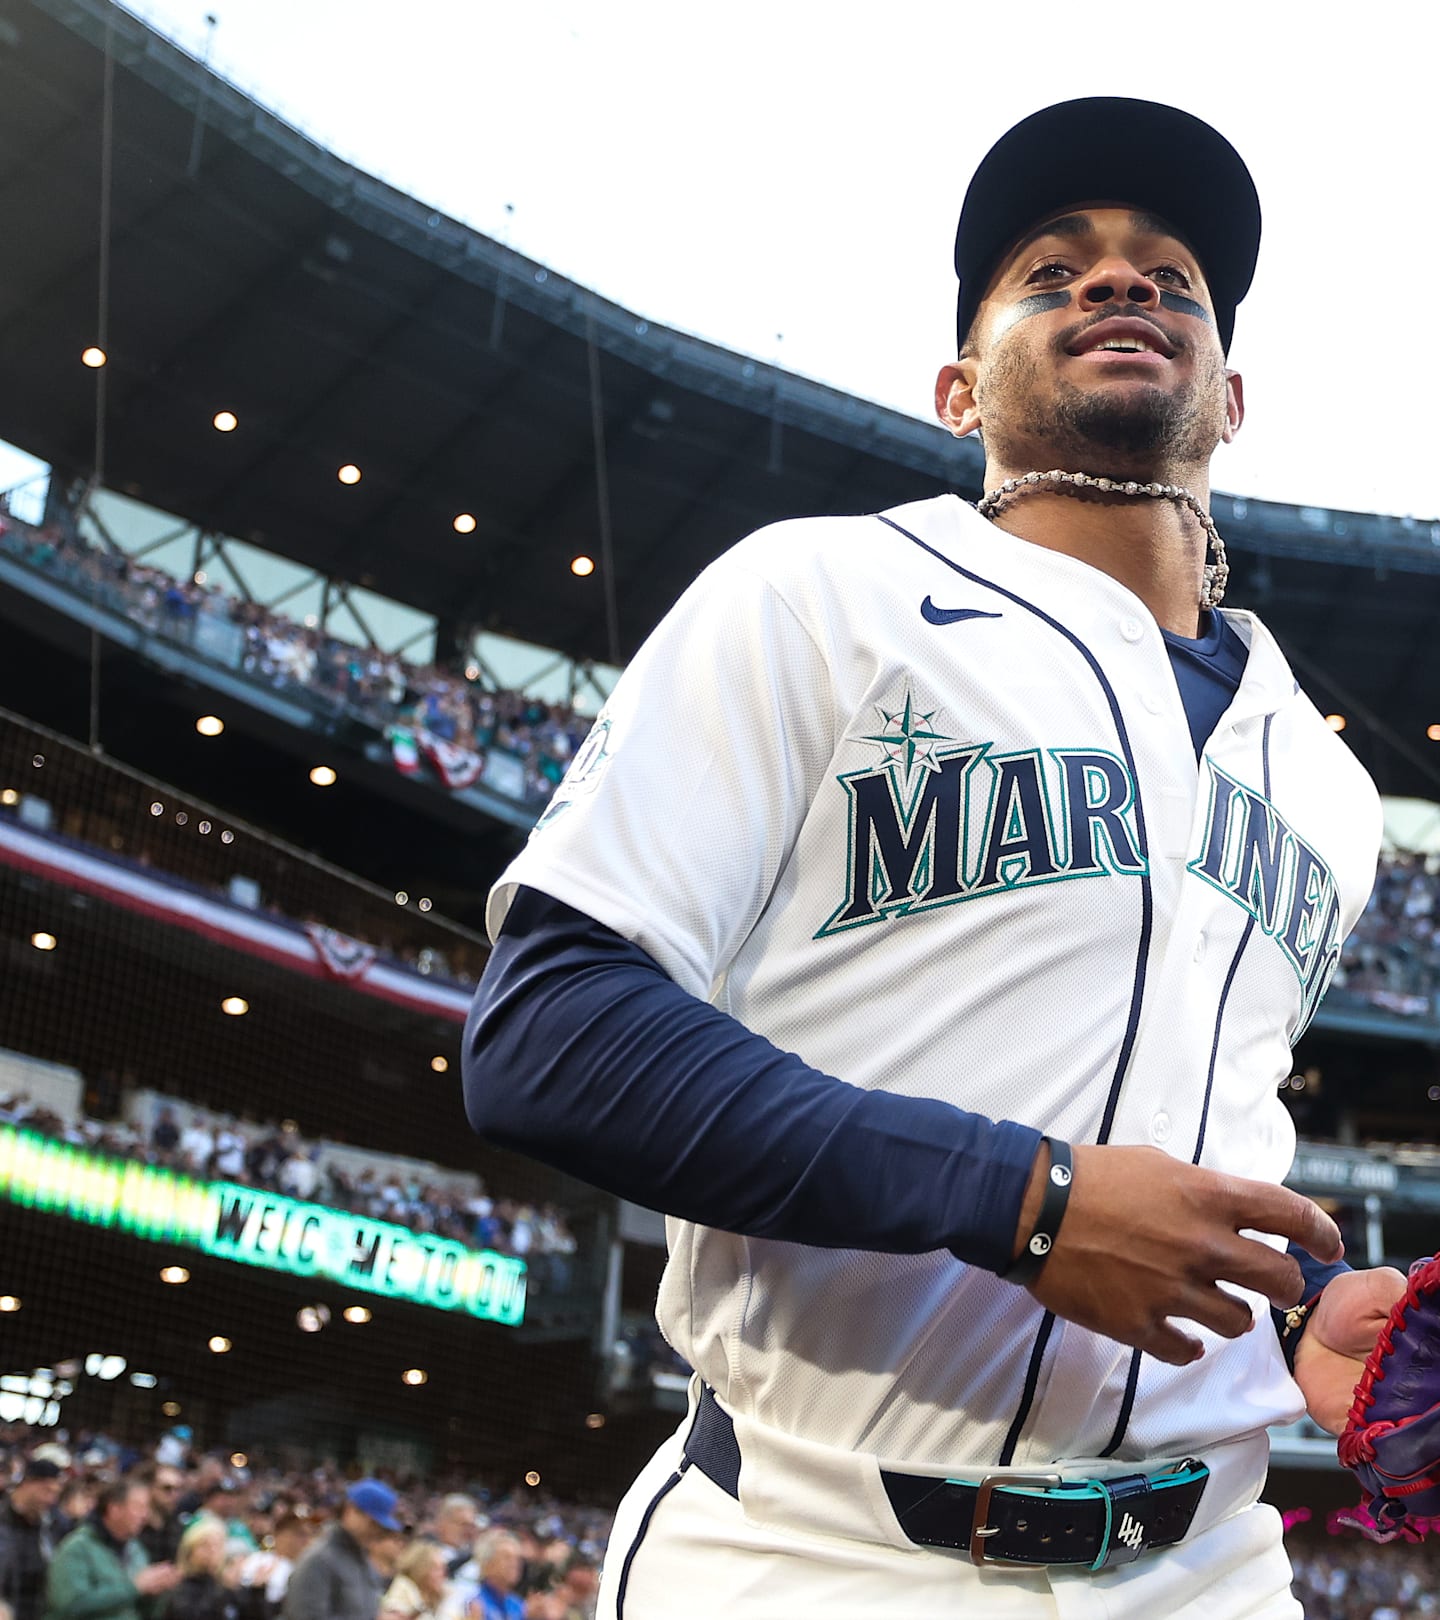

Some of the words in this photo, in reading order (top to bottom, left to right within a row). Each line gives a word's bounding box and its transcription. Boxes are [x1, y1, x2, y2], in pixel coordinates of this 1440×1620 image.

[812, 741, 1342, 1048] MARINER
[215, 1193, 406, 1286] WELCME
[417, 1245, 458, 1300] TO
[1117, 1512, 1144, 1550] 44
